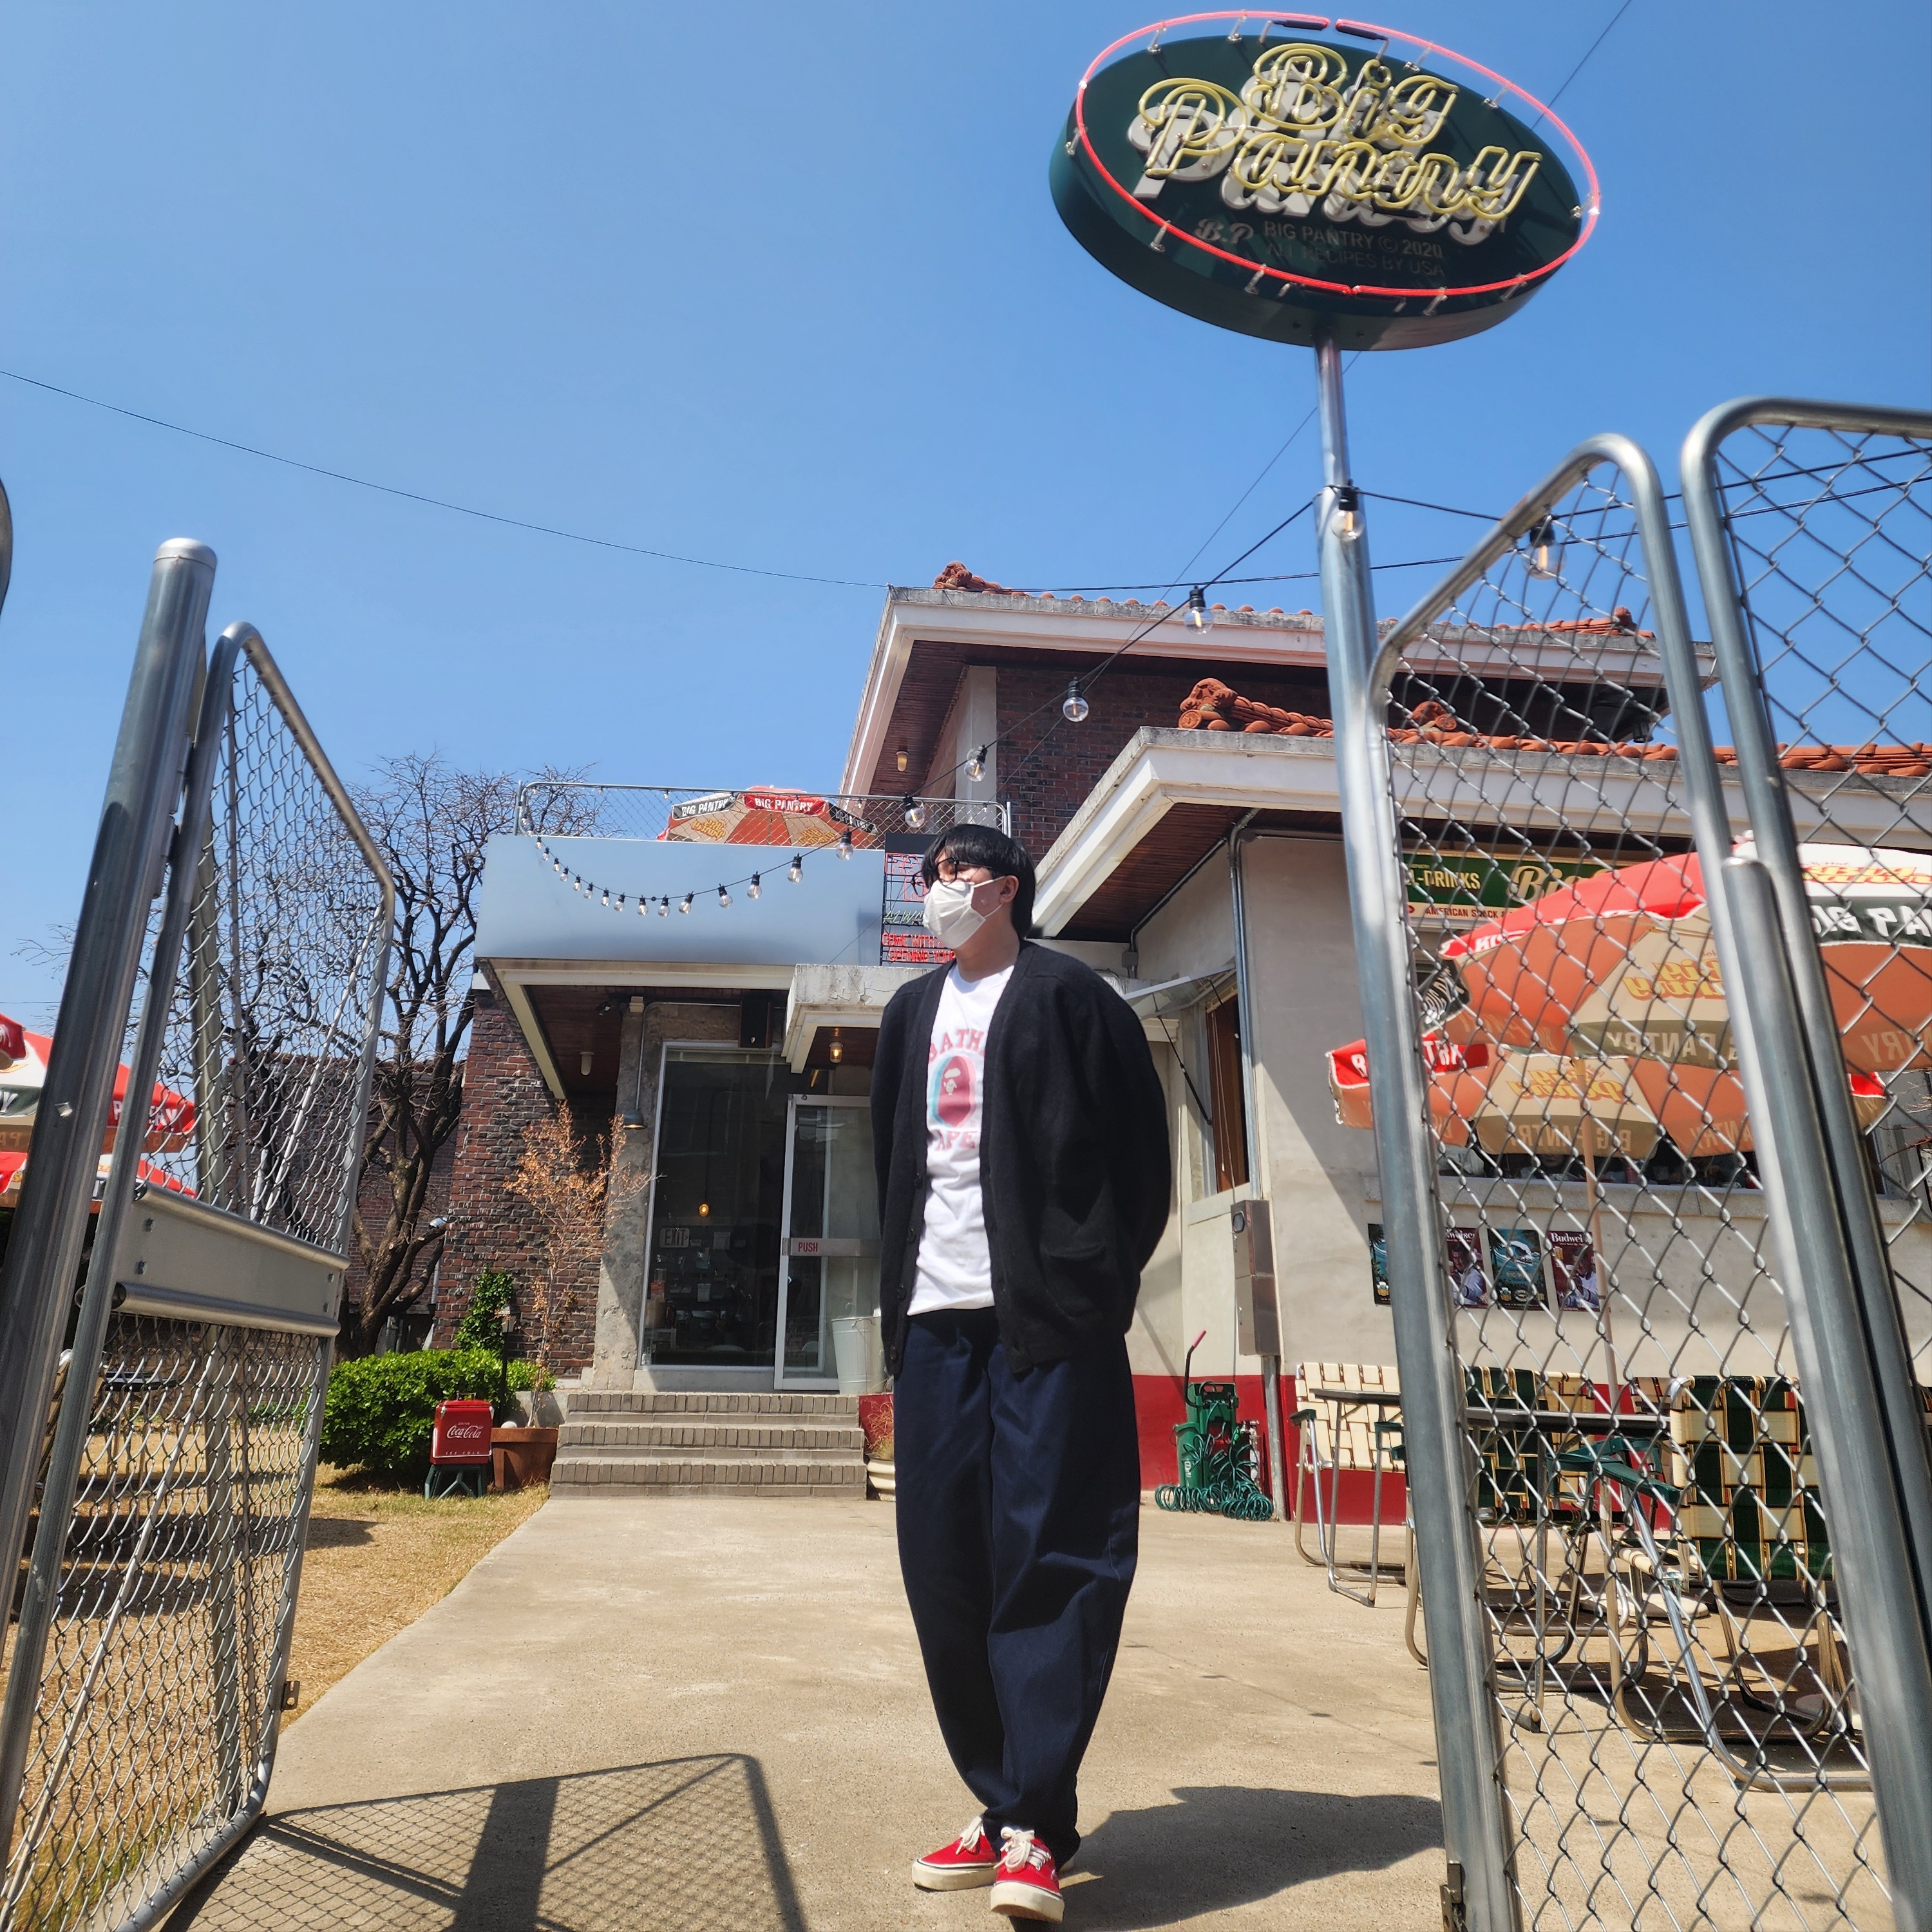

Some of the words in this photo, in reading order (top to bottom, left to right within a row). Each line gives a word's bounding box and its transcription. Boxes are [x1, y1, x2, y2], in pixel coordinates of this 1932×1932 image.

[1236, 43, 1459, 151] Big
[1131, 77, 1544, 232] Pantry
[1264, 220, 1296, 240] BIG
[1302, 224, 1374, 250] PANTRY
[1401, 239, 1443, 260] 2020
[1302, 245, 1378, 269] RECIPES
[1381, 257, 1403, 271] BY
[1409, 260, 1446, 277] USA
[681, 806, 696, 817] BIG
[698, 799, 728, 814] PANTRY
[755, 797, 771, 810] BIG
[775, 799, 813, 812] PANTRY
[1406, 869, 1481, 890] L-DRINKS
[882, 910, 923, 925] ALWA
[1425, 907, 1468, 917] AMERICAN
[935, 1130, 978, 1151] APE
[665, 1229, 686, 1246] EXIT
[798, 1242, 818, 1253] PUSH
